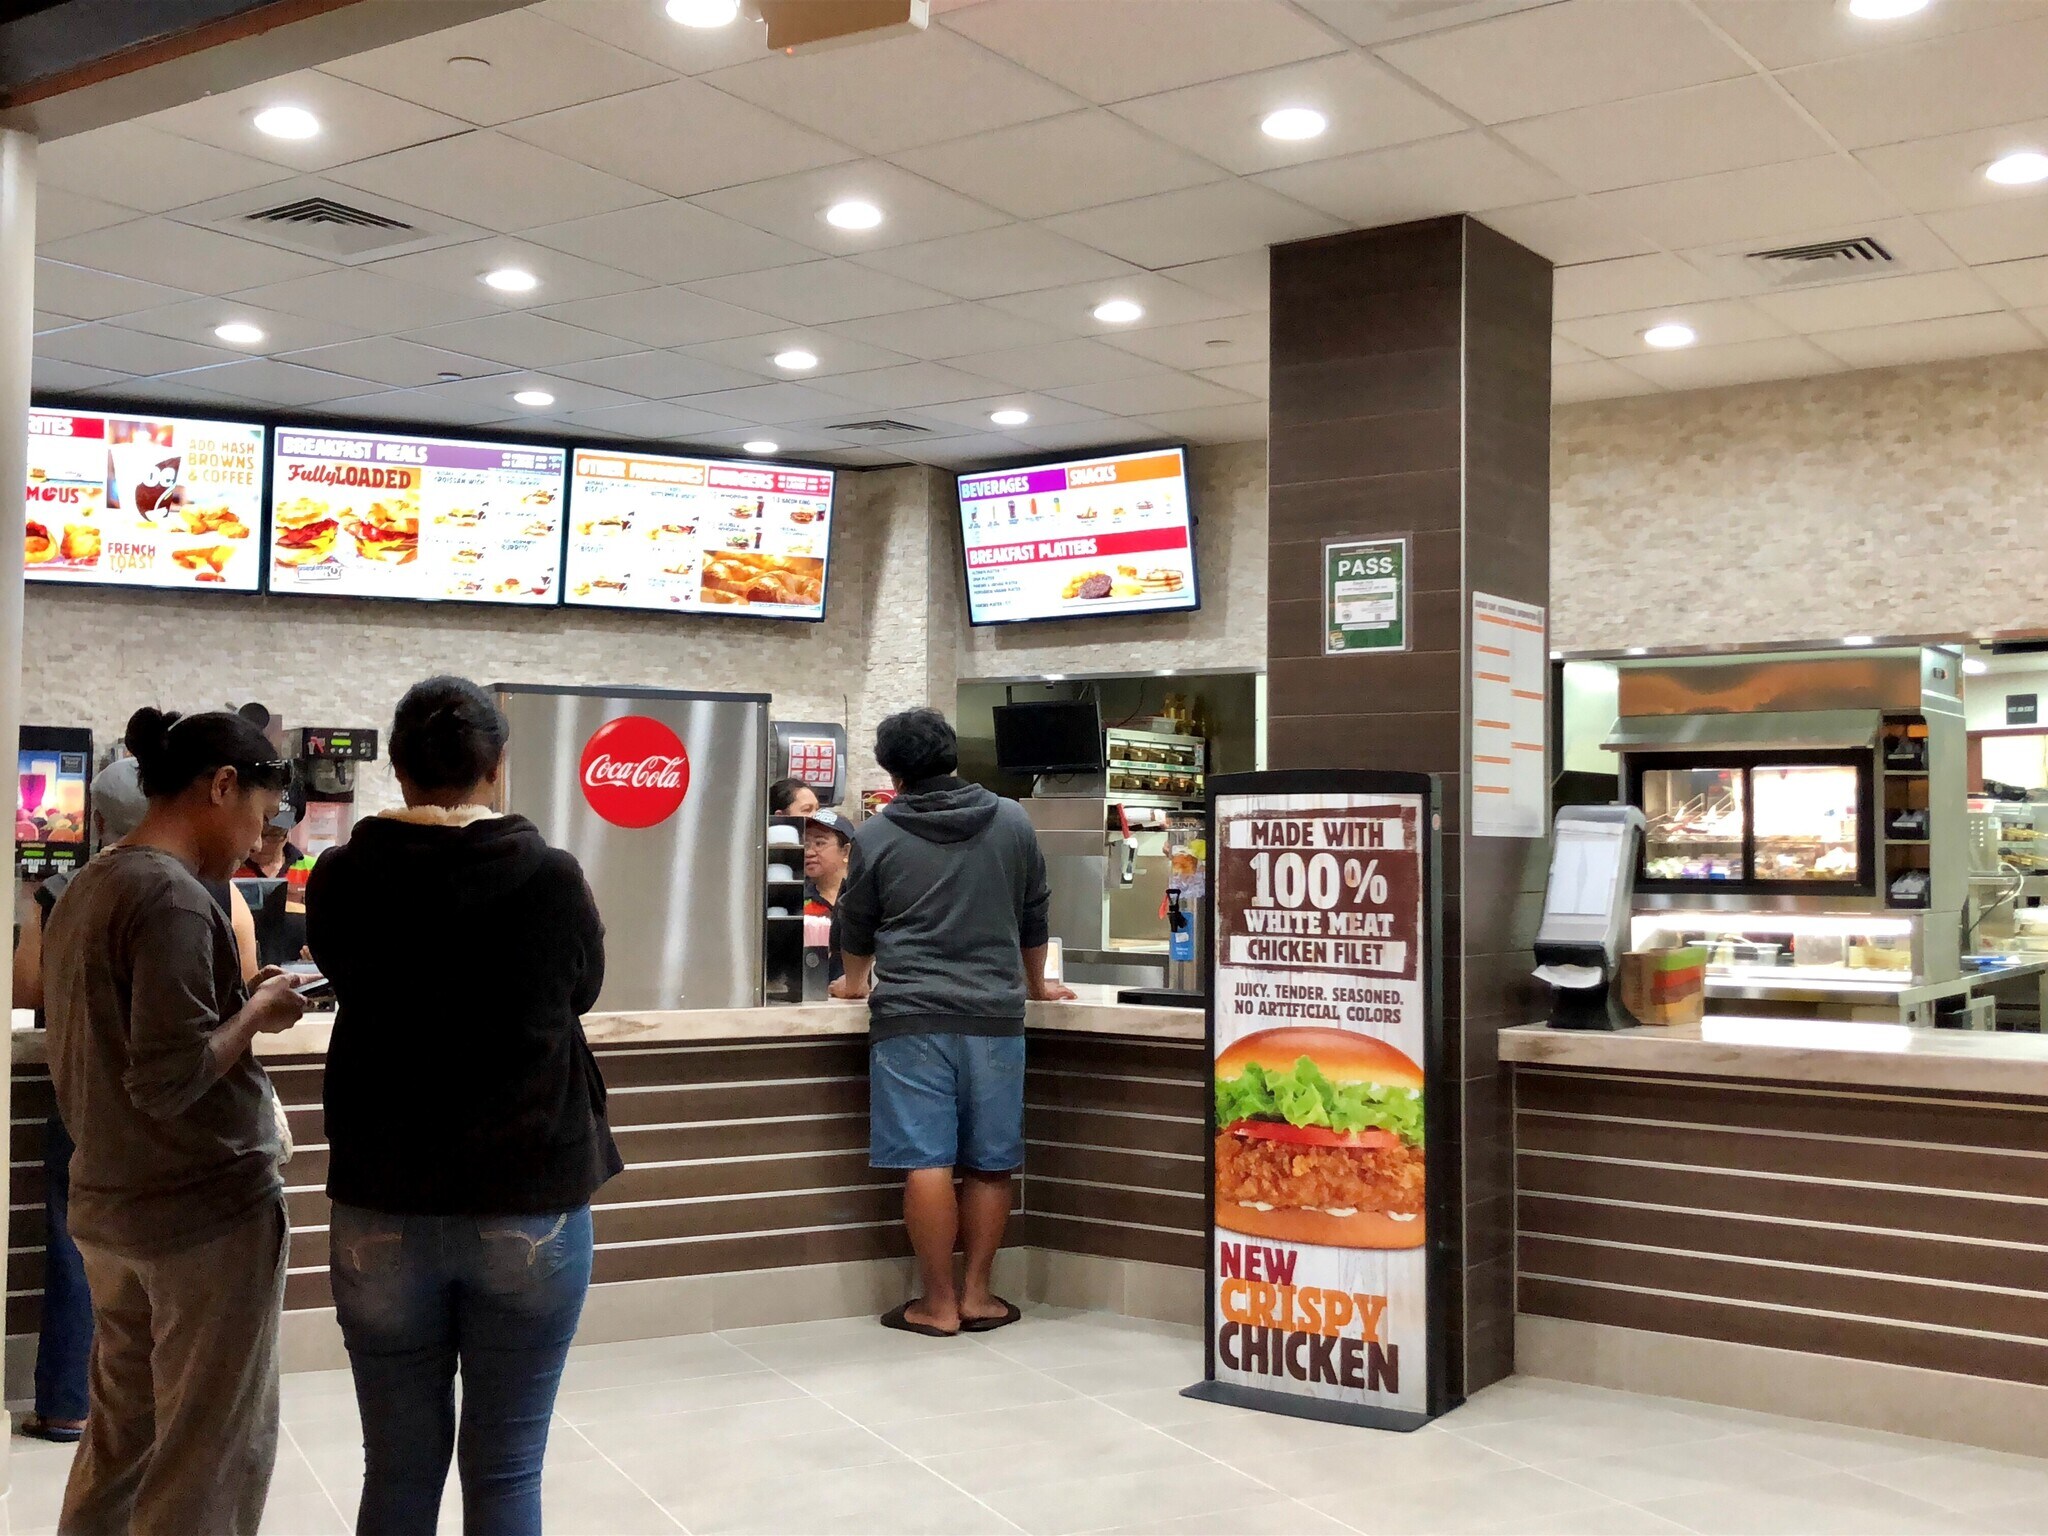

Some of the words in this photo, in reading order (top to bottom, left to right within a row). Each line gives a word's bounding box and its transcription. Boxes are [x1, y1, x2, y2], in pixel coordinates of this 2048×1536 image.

[189, 439, 215, 451] ADD
[222, 442, 254, 454] HASH
[282, 436, 373, 460] BREAKFAST
[376, 442, 428, 464] MEALS
[188, 452, 254, 469] BROWNS
[188, 469, 198, 481] &
[203, 469, 253, 485] COFFEE
[961, 476, 1030, 498] BEVERAGES
[1069, 465, 1117, 486] SNACKS
[108, 542, 156, 556] FRENCH
[109, 554, 154, 570] TOAST
[969, 544, 1036, 565] BREAKFAST
[1038, 538, 1098, 559] PLATTERS
[1337, 556, 1393, 577] PASS
[585, 753, 686, 789] Coca-Cola
[1251, 821, 1314, 847] MADE
[1323, 821, 1384, 848] WITH
[1249, 851, 1388, 910] 100%
[1243, 909, 1322, 936] WHITE
[1327, 911, 1394, 938] MEAT
[1247, 939, 1328, 964] CHICKEN
[1333, 943, 1384, 965] FILET
[1234, 982, 1270, 999] JUICY.
[1275, 984, 1328, 1002] TENDER.
[1332, 986, 1404, 1006] SEASONED.
[1234, 999, 1253, 1015] NO
[1258, 1002, 1341, 1021] ARTIFICIAL
[1346, 1006, 1402, 1024] COLORS
[1220, 1241, 1298, 1286] NEW
[1220, 1277, 1388, 1343] CRISPY
[1219, 1320, 1399, 1394] CHICKEN
